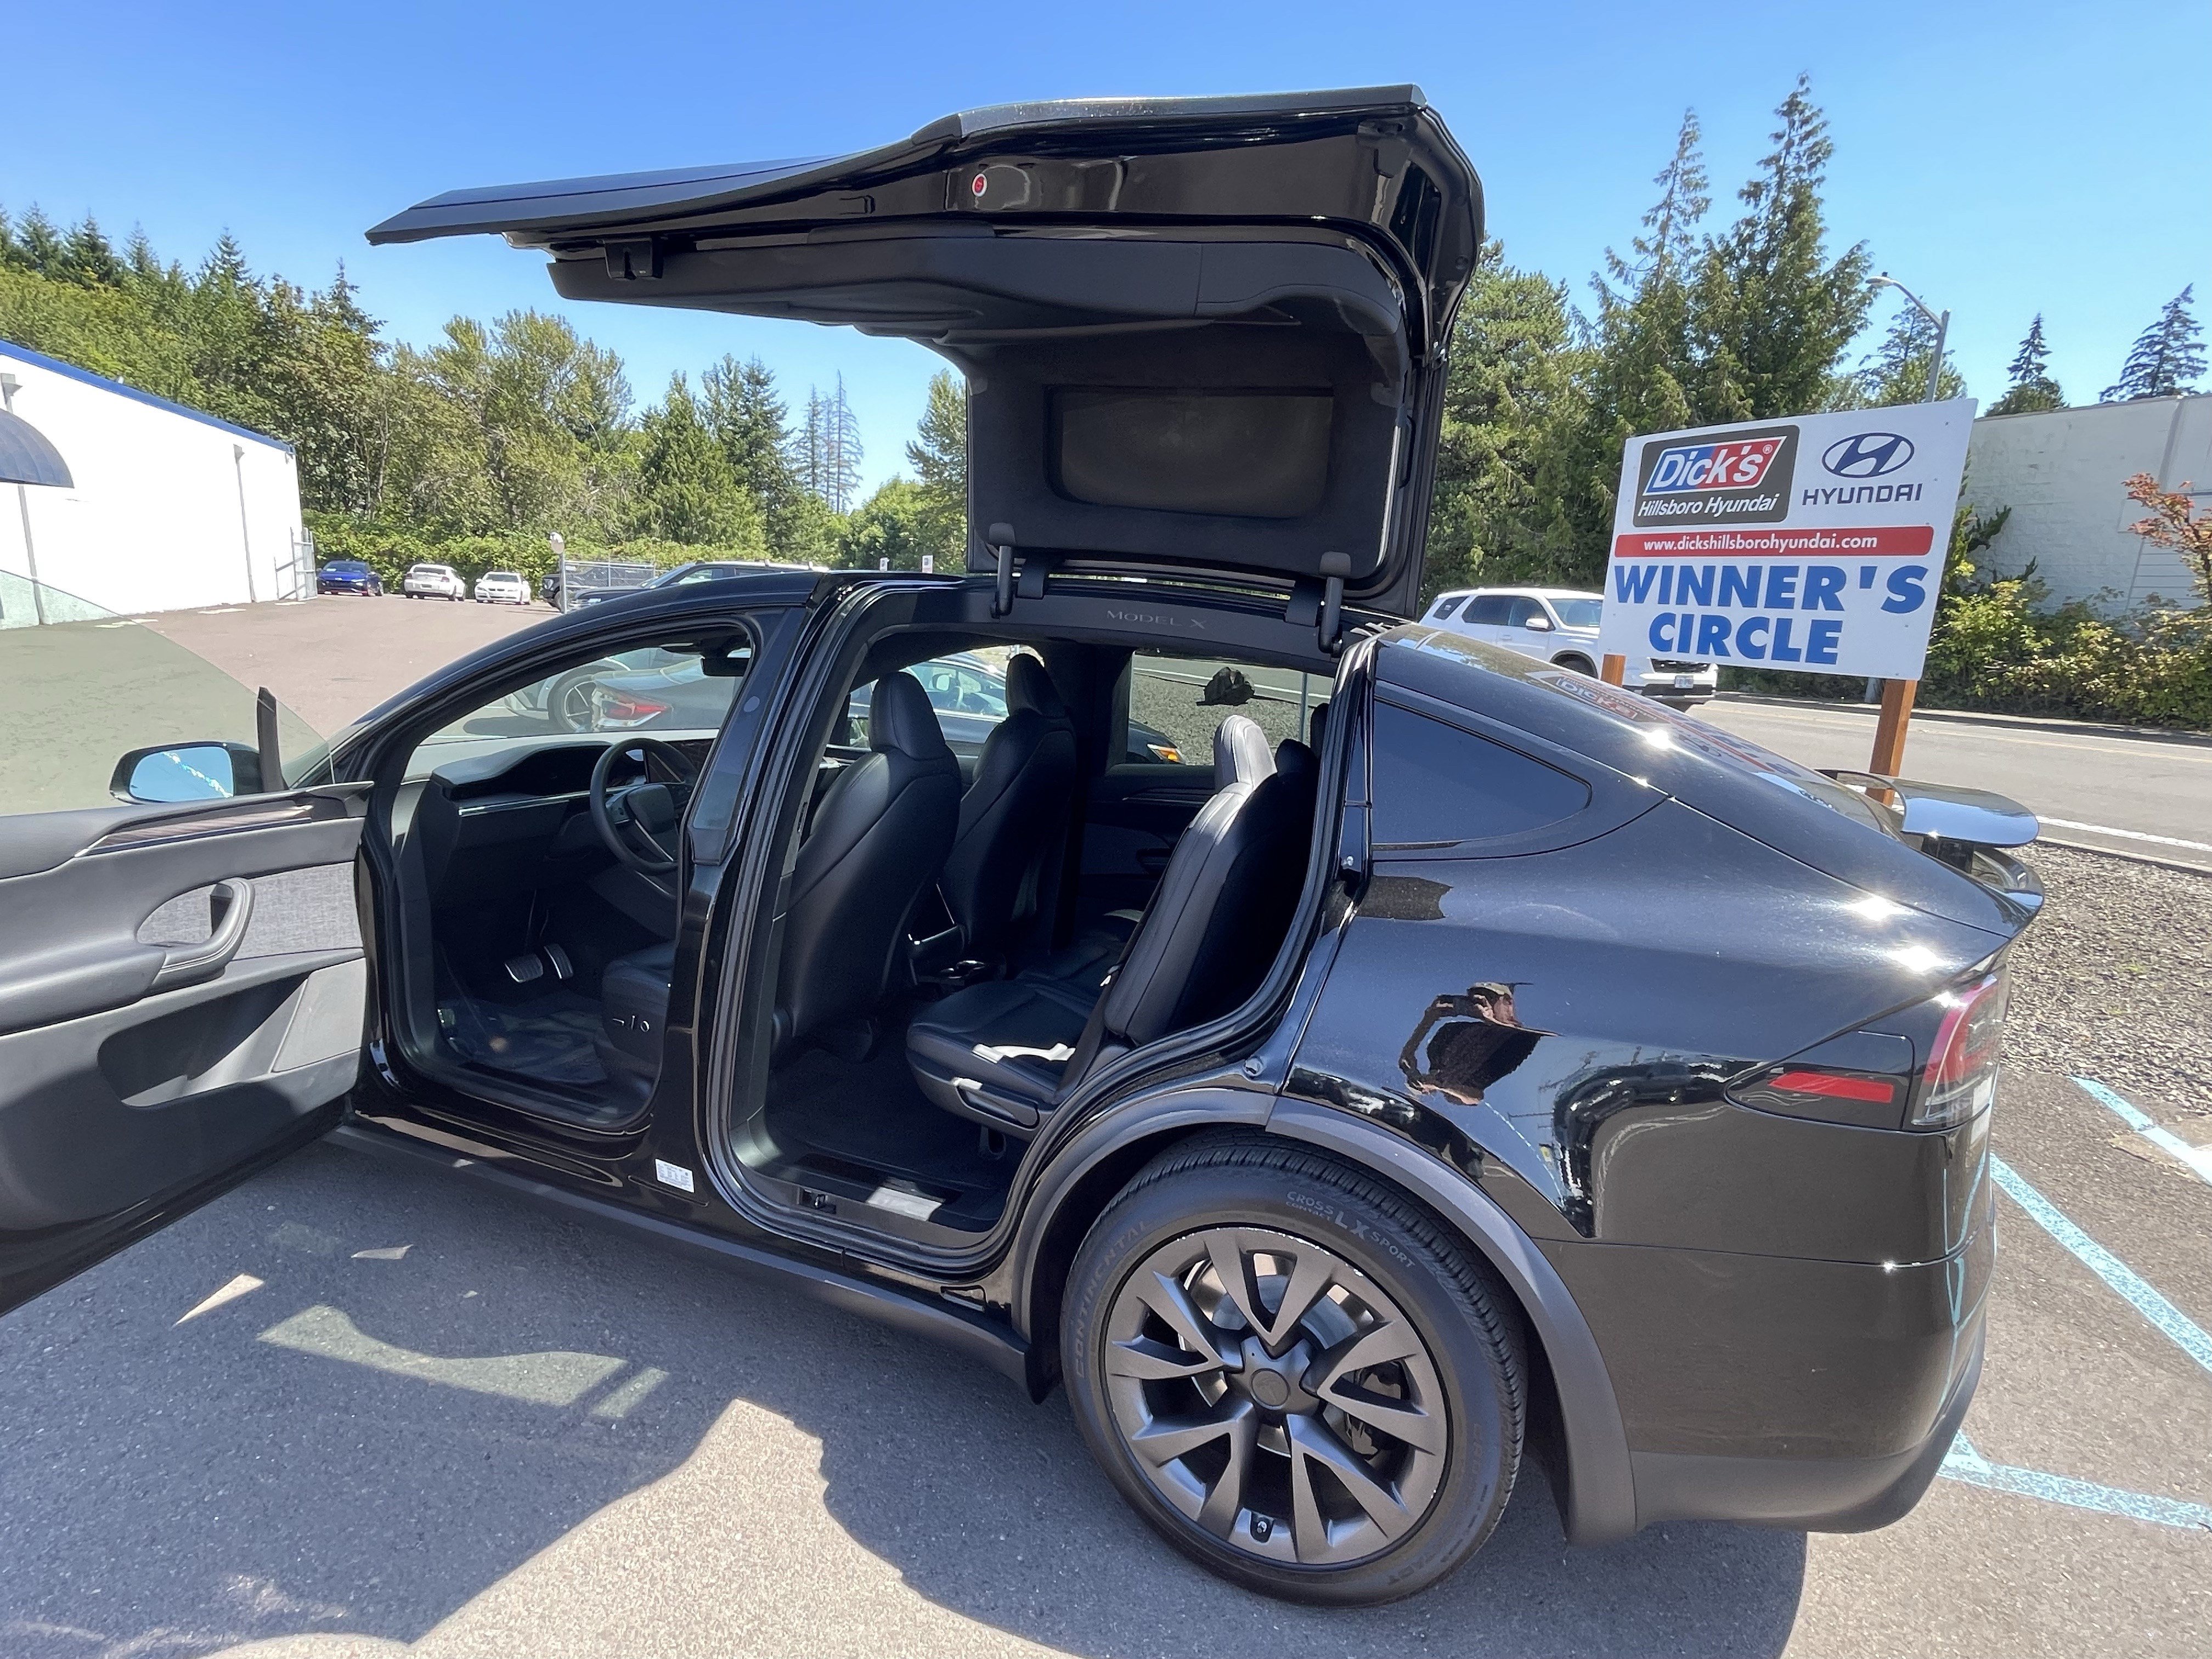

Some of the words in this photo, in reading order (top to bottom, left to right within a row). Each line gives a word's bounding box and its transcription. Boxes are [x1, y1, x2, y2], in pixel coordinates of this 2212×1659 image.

[1638, 499, 1702, 517] Hillsboro
[1705, 493, 1780, 518] Hyundai
[1802, 483, 1923, 505] HYUNDAI
[1644, 533, 1877, 554] www.dickshillsborohyundai.com
[1614, 565, 1928, 614] WINNER'S
[1106, 610, 1183, 627] MODEL
[1190, 619, 1207, 629] X
[1649, 612, 1843, 665] CIRCLE
[1286, 1190, 1333, 1214] CROSS
[1369, 1231, 1415, 1267] SPORT
